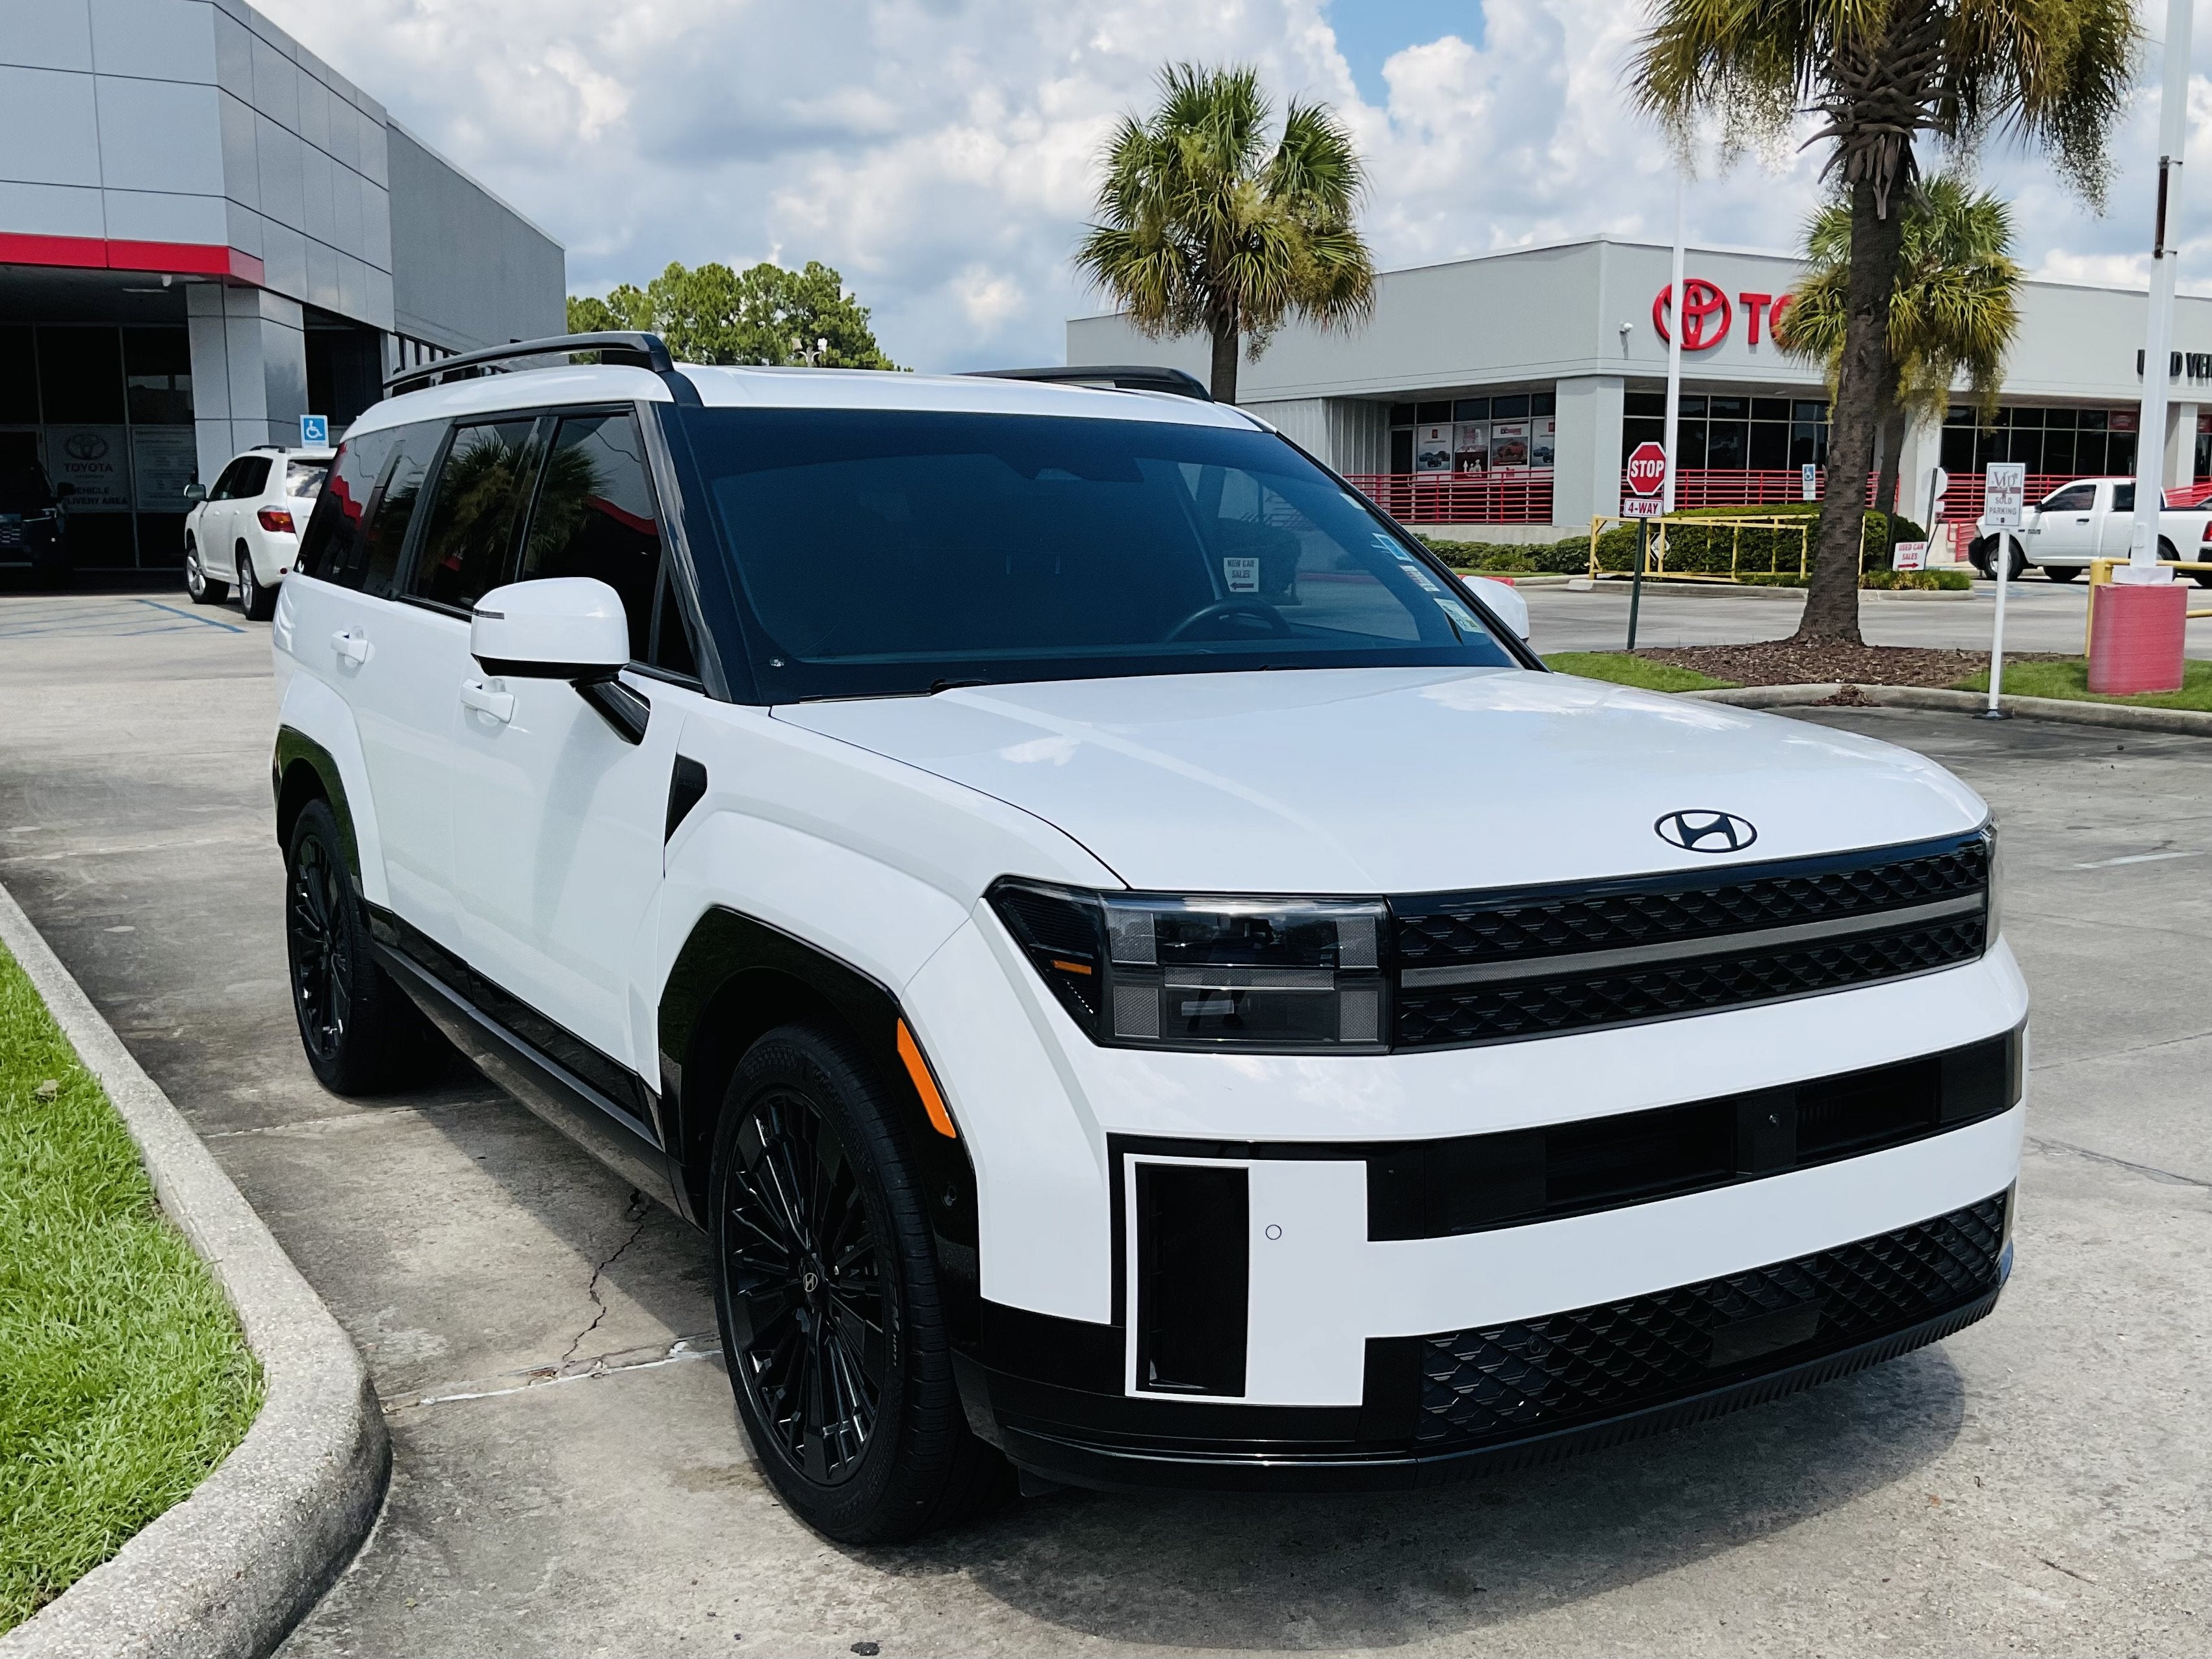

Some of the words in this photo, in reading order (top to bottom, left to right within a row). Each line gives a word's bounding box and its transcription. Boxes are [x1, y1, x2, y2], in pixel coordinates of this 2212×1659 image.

[64, 463, 113, 472] TOYOTA
[1630, 459, 1664, 478] STOP
[1628, 502, 1658, 515] 4-WAY
